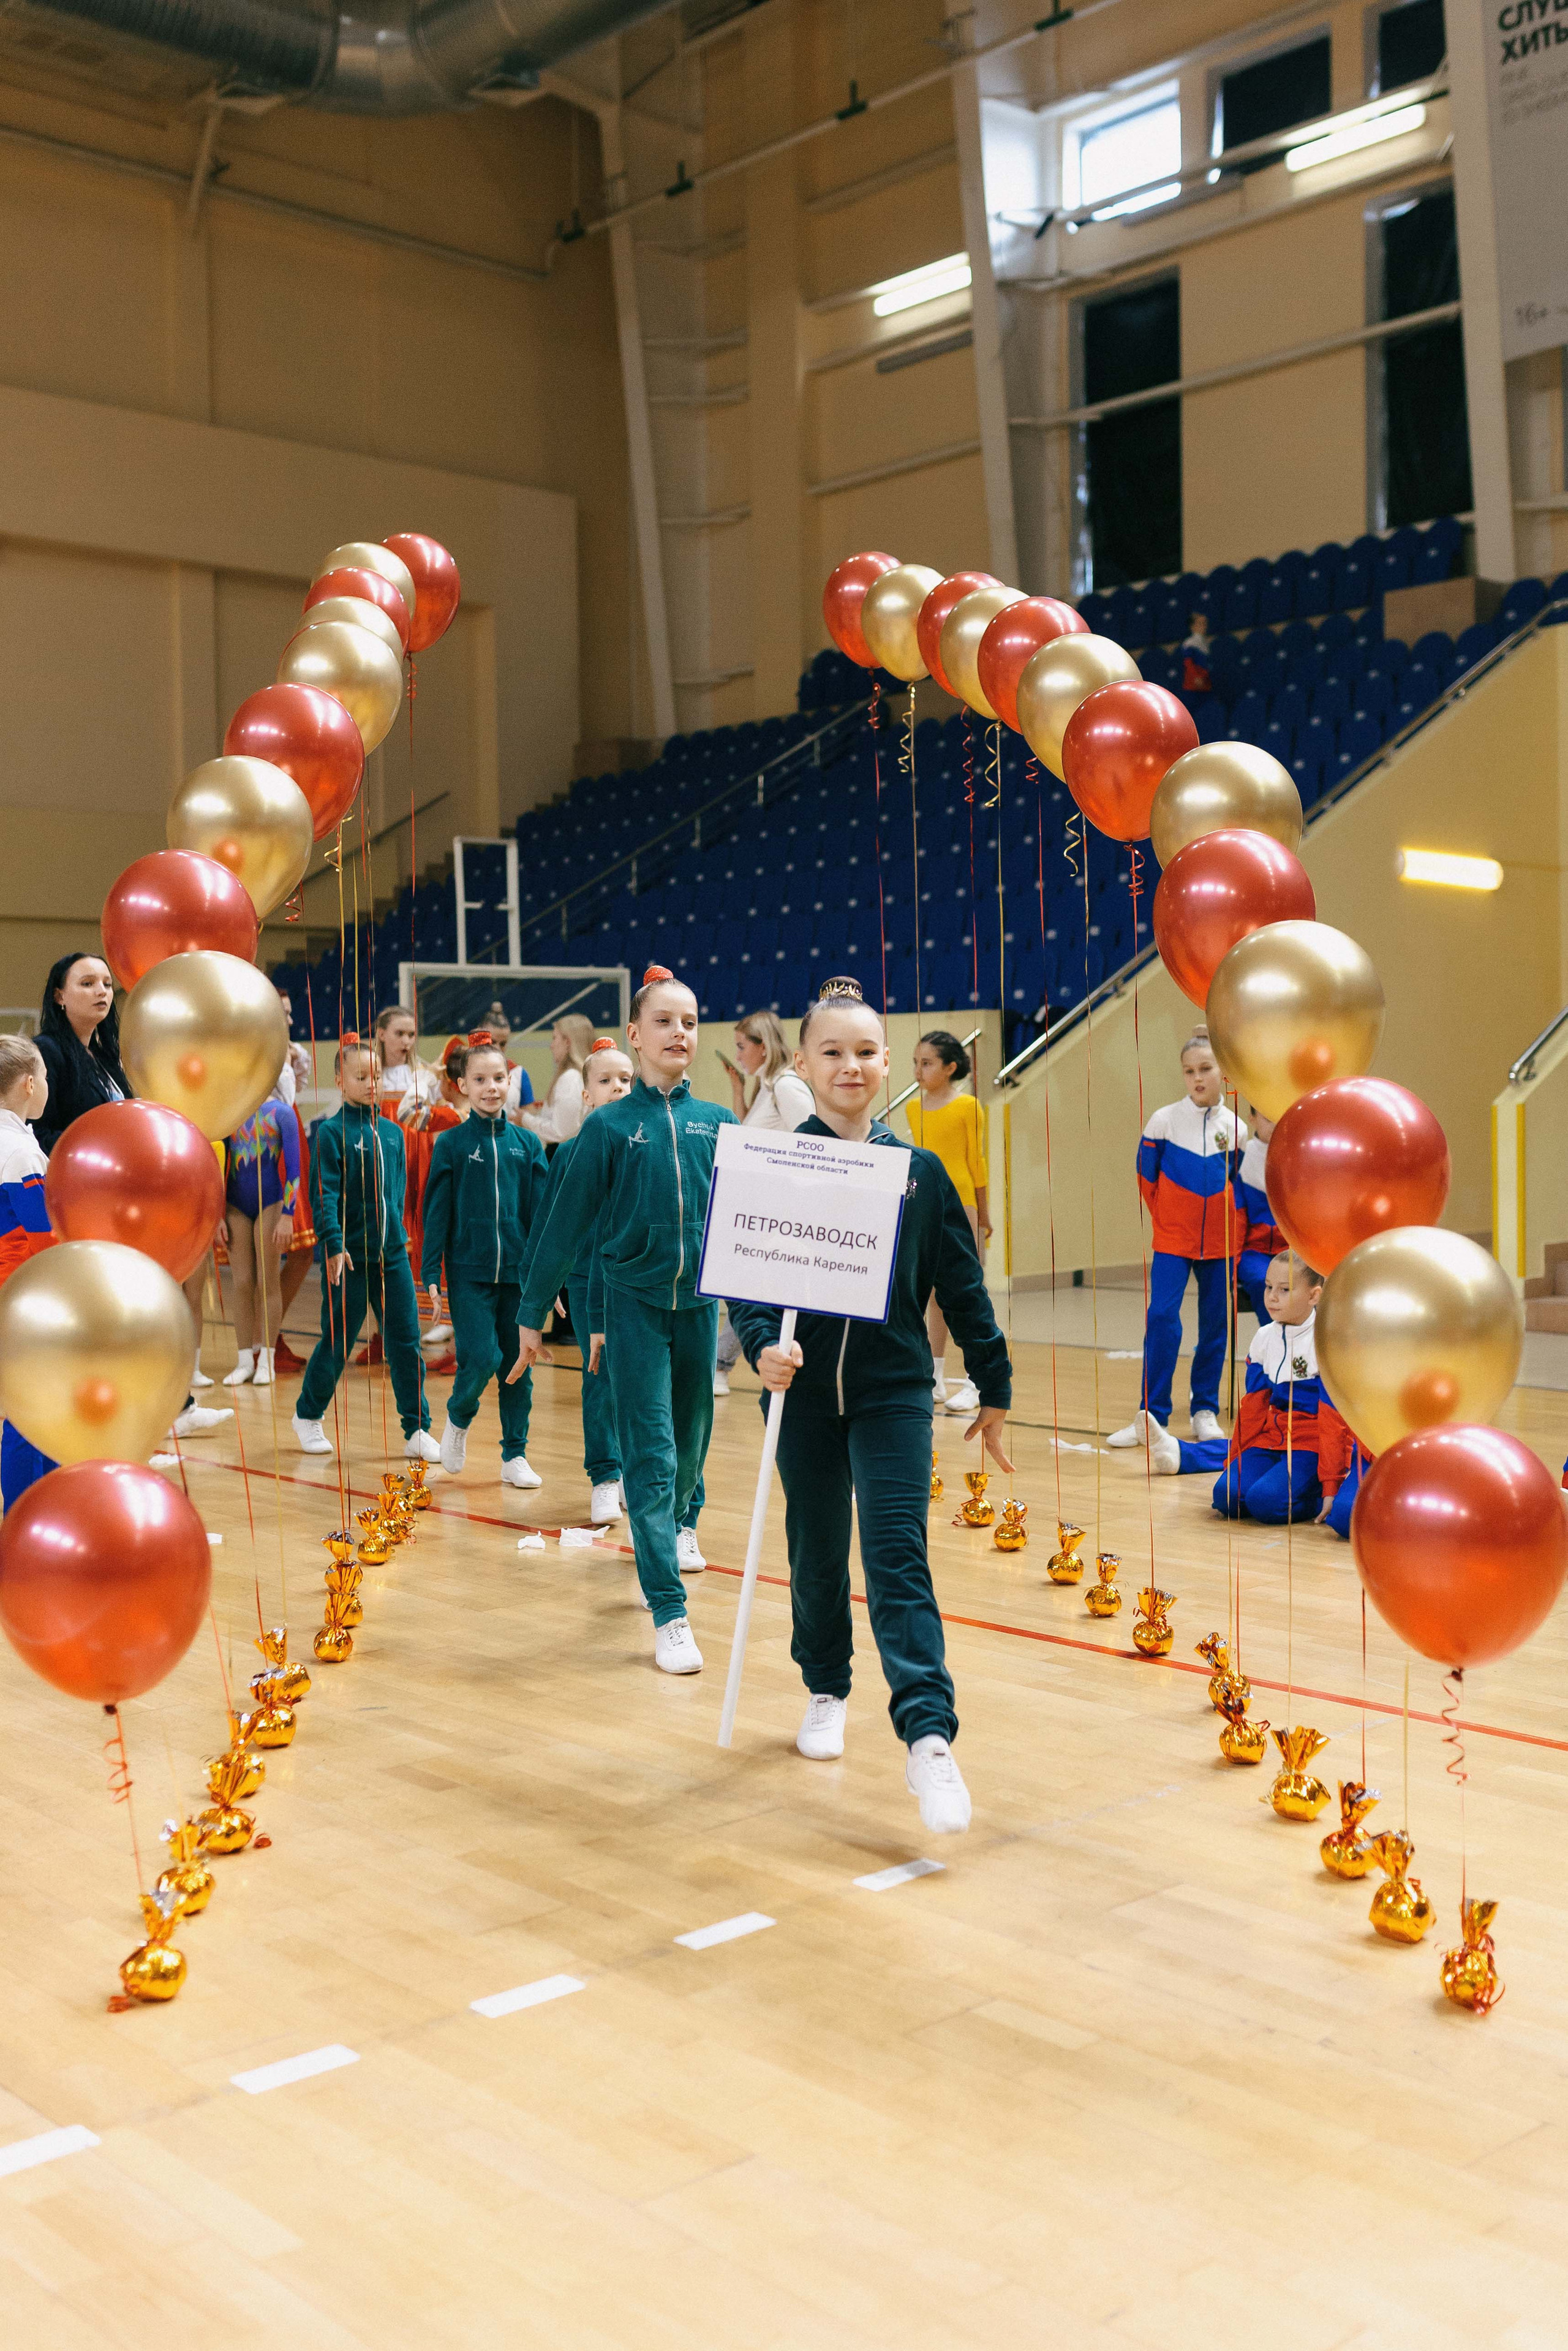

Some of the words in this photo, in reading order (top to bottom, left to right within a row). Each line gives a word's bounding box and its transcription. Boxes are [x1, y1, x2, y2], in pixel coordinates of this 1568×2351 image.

[687, 1121, 715, 1131] Bychuk
[744, 1143, 787, 1155] Федерация
[788, 1151, 836, 1163] спортивной
[837, 1158, 874, 1168] аэробики
[797, 1140, 824, 1152] РСОО
[766, 1157, 815, 1170] Смоленской
[816, 1165, 848, 1175] области
[734, 1213, 878, 1250] ПЕТРОЗАВОДСК
[734, 1243, 809, 1265] Республика
[813, 1256, 868, 1275] Карелия
